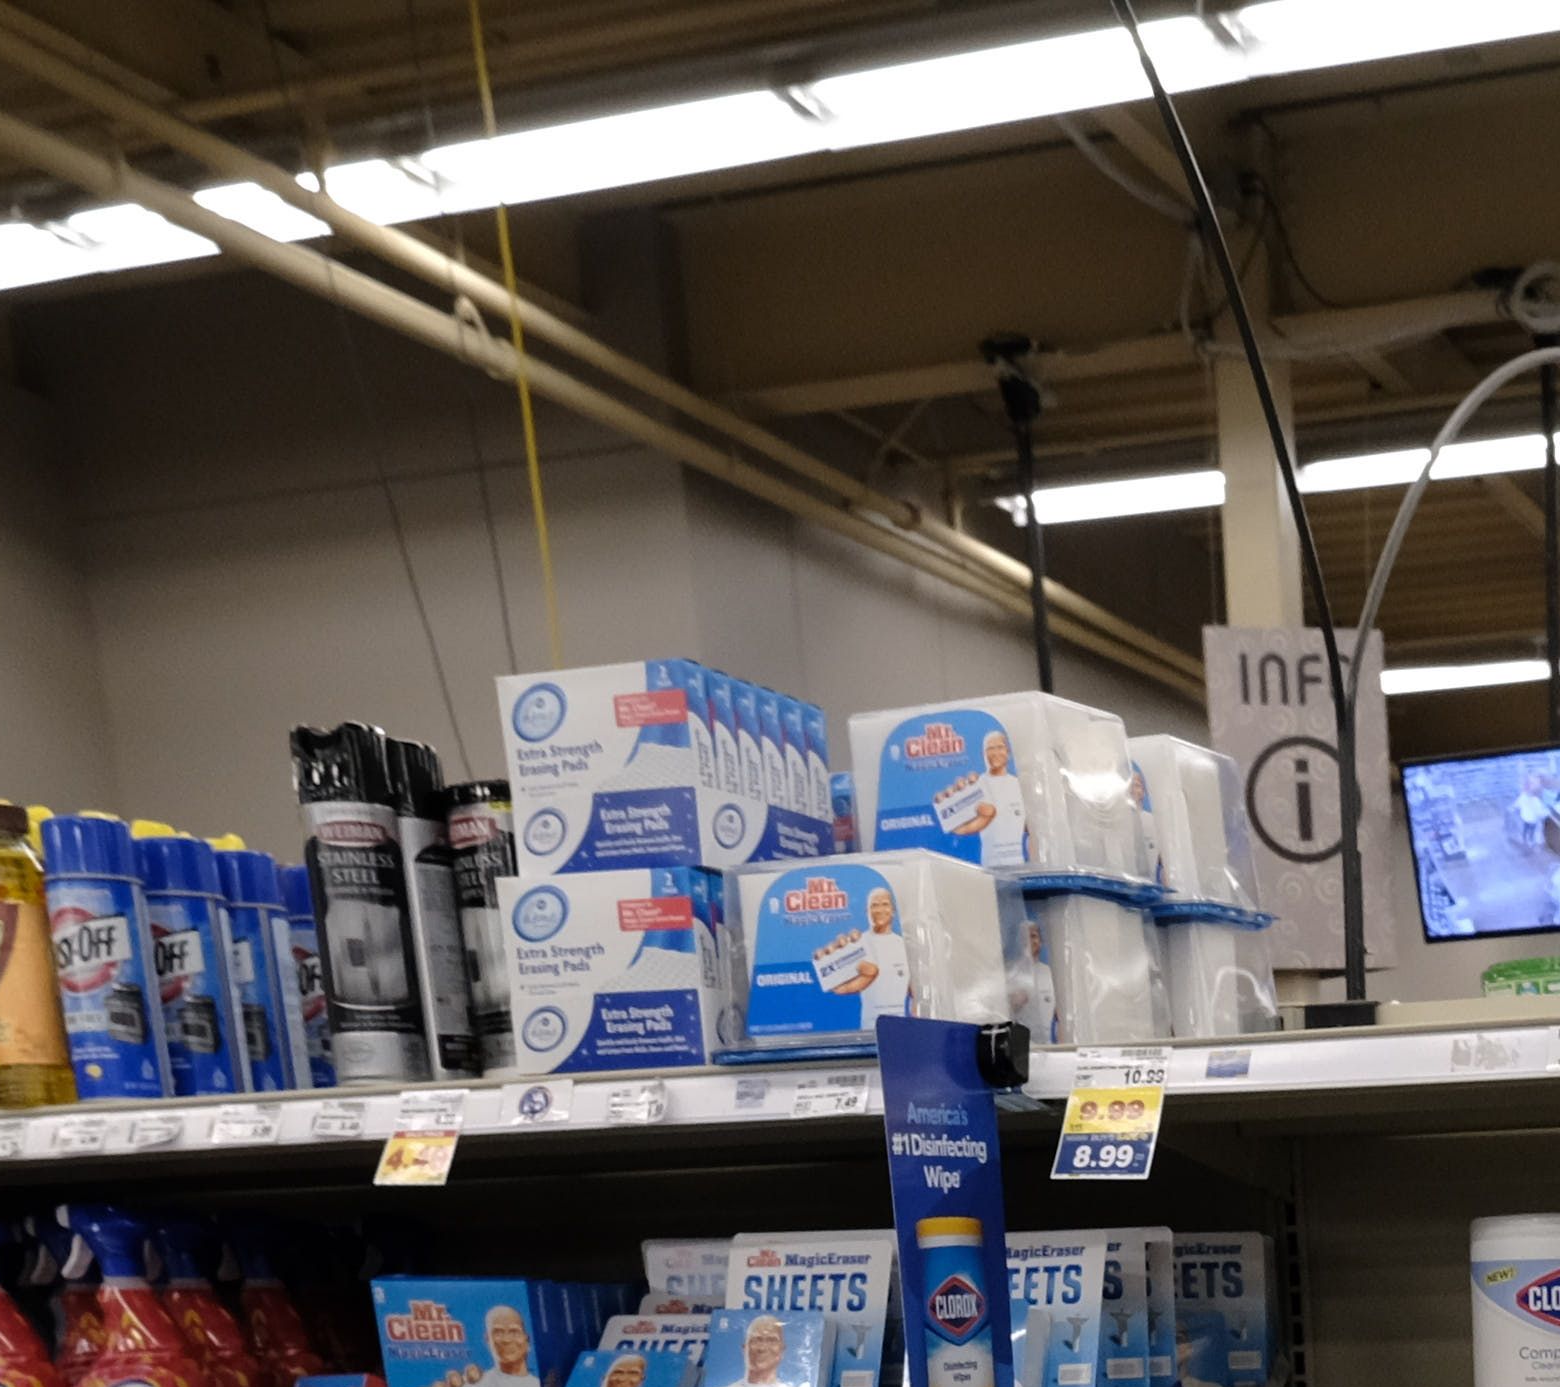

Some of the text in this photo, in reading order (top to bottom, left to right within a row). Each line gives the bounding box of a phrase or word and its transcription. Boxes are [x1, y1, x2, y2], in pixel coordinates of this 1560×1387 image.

[906, 737, 964, 759] Clean
[786, 890, 846, 912] Clean
[757, 971, 813, 986] ORIGINAL
[1072, 1145, 1134, 1169] 8.99
[924, 1166, 961, 1189] Wipe
[743, 1273, 868, 1313] SHEETS
[386, 1317, 464, 1342] Clean
